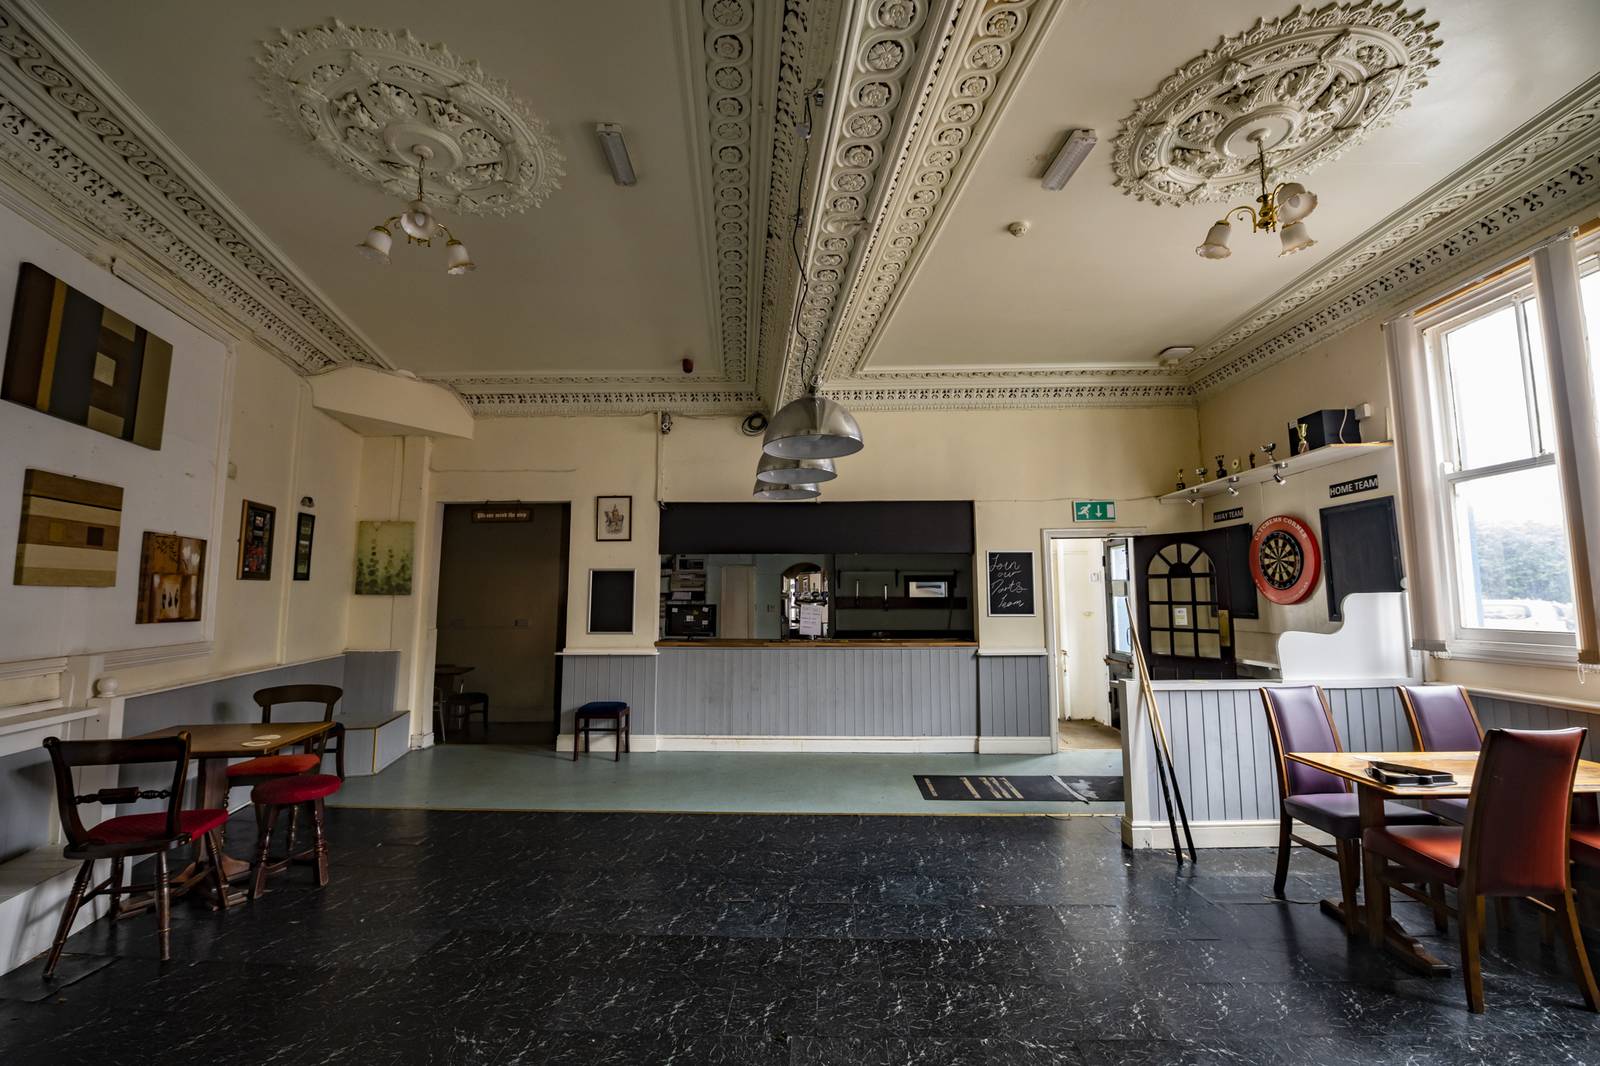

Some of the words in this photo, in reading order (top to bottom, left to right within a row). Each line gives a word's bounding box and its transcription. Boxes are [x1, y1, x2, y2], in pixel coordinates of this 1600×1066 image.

[1330, 484, 1354, 496] HOME
[1354, 478, 1378, 491] TEAM
[1214, 512, 1228, 520] AWAY
[1228, 509, 1243, 518] TEAM
[1283, 517, 1308, 539] CORNER
